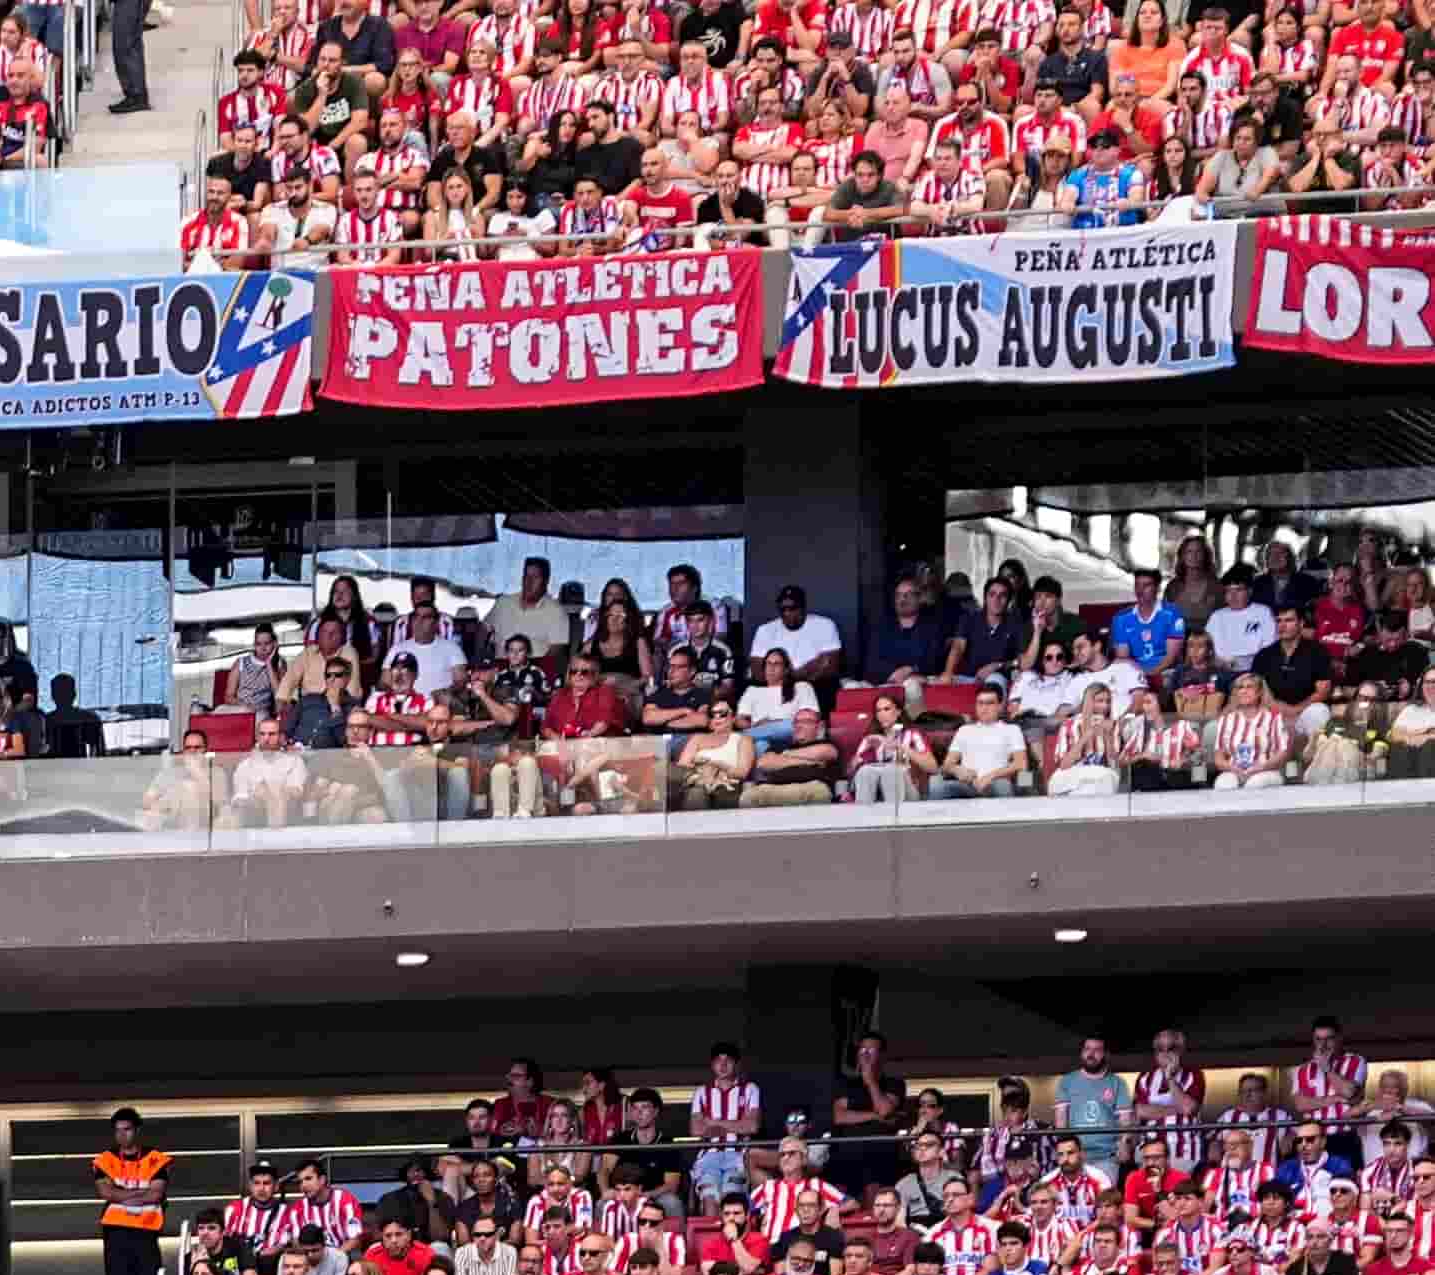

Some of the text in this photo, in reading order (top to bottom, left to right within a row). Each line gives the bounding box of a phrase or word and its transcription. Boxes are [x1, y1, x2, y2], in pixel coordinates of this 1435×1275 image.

[1014, 236, 1216, 273] PEÑA ATLÉTICA
[499, 255, 732, 310] ATLÉTICA
[348, 303, 737, 390] PATONES
[828, 274, 1217, 373] LUCUS AUGUSTI
[30, 395, 112, 417] ADICTOS
[118, 394, 157, 413] ATM
[162, 391, 200, 411] P-13
